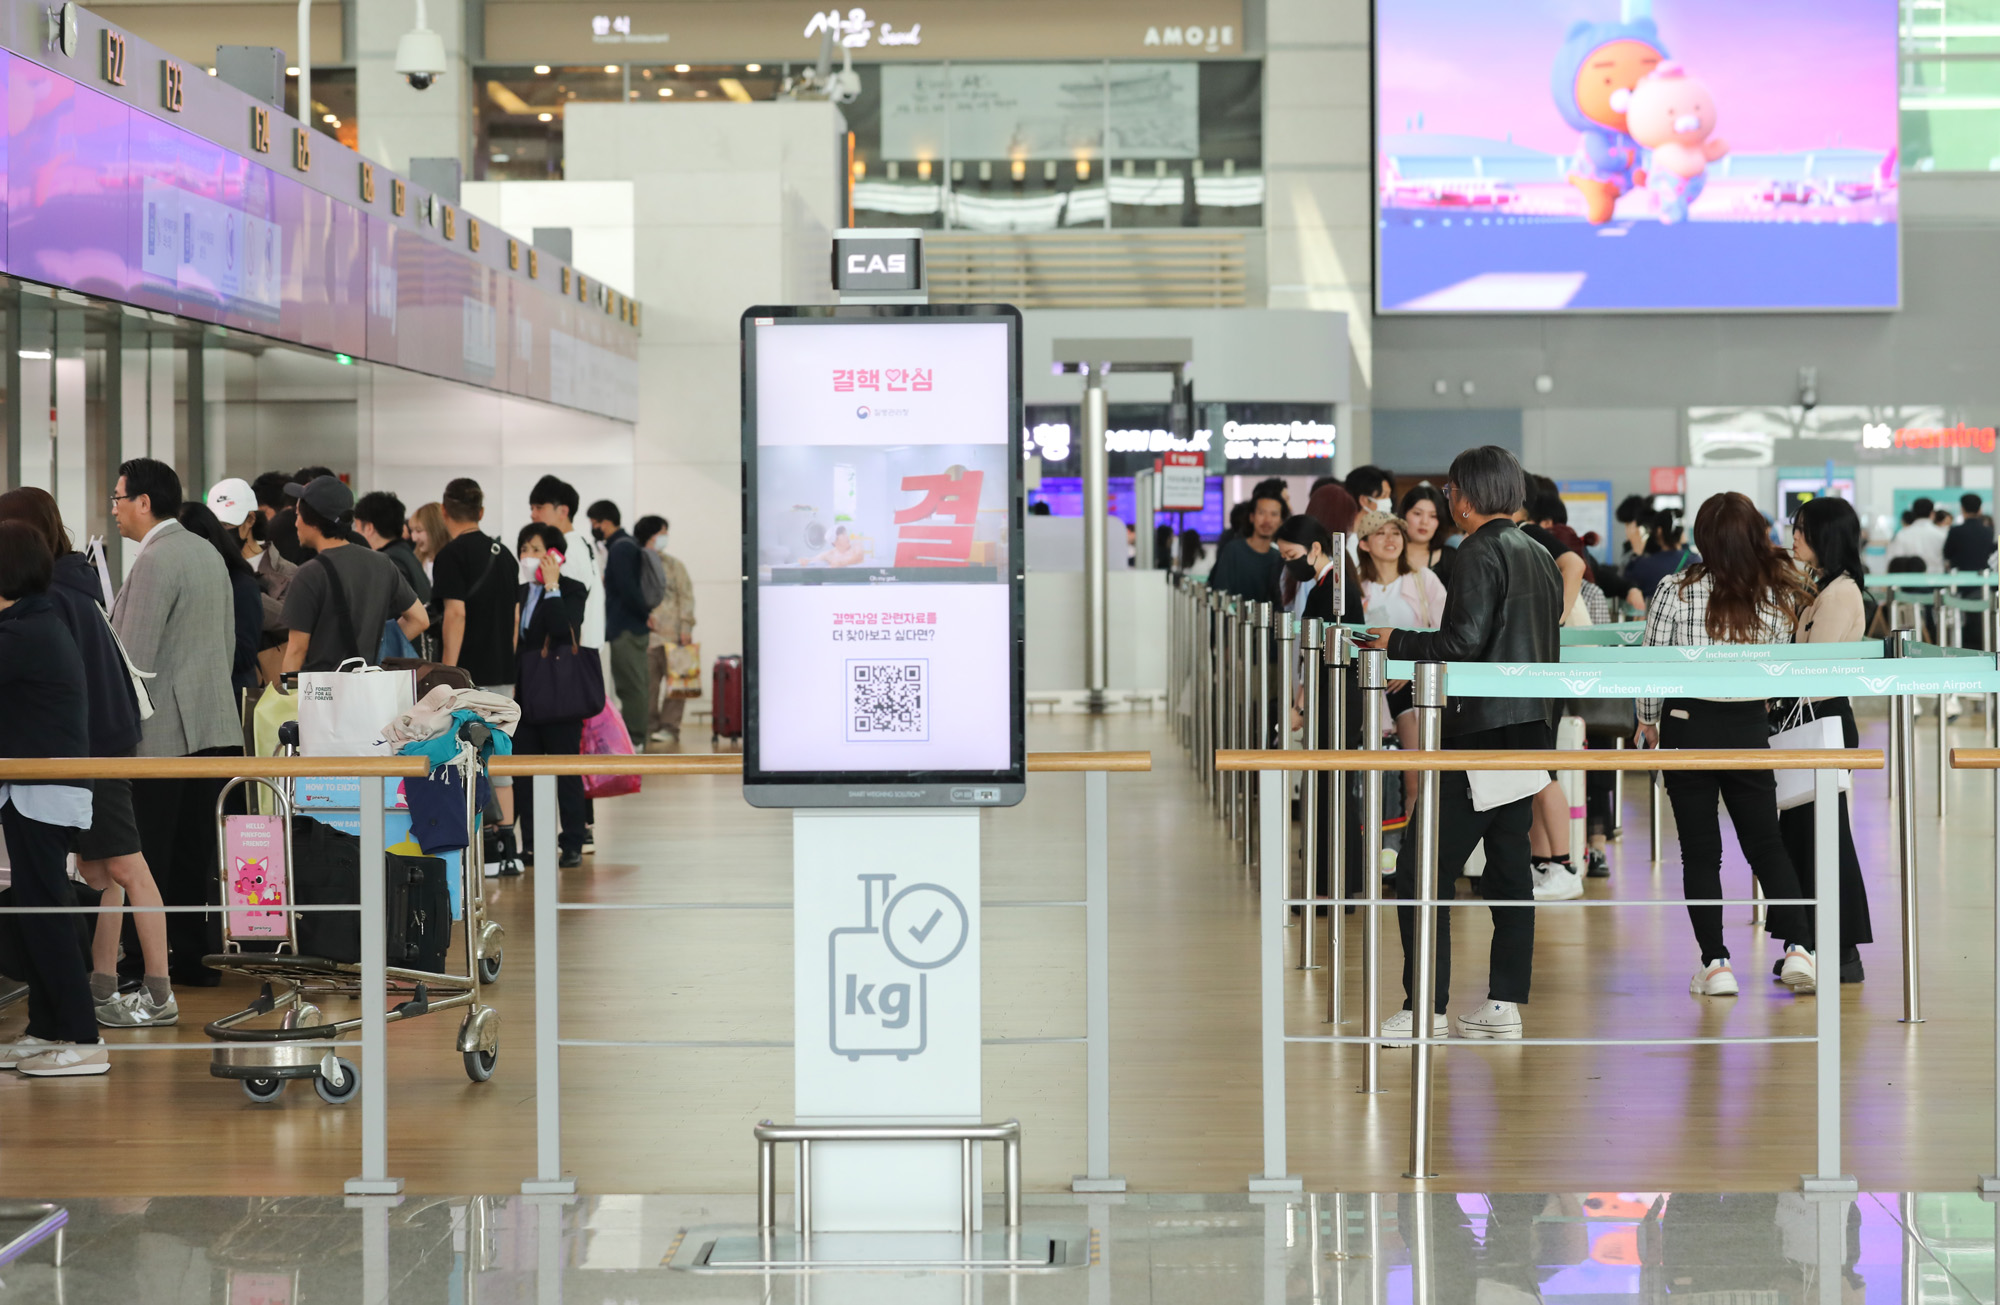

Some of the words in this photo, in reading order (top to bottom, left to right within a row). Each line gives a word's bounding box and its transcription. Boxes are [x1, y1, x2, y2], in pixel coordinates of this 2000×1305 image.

[101, 29, 126, 86] F22
[162, 60, 183, 112] F23
[251, 106, 270, 153] F24
[847, 254, 906, 273] CAS
[832, 369, 880, 392] 결핵
[885, 368, 933, 392] 안심
[893, 470, 984, 568] 결
[881, 612, 937, 625] 관련자료를
[832, 629, 843, 641] 더
[846, 629, 891, 641] 찾아보고
[894, 629, 935, 641] 싶다면?
[1704, 651, 1738, 660] Incheon
[1740, 650, 1771, 661] Airport
[1791, 666, 1829, 675] Incheon
[1831, 665, 1865, 677] Airport
[1598, 684, 1641, 694] Incheon
[1644, 684, 1684, 696] Airport
[1896, 680, 1940, 691] Incheon
[1943, 679, 1983, 693] Airport
[305, 783, 324, 791] HOW
[325, 783, 336, 791] TO
[242, 840, 270, 848] FRIENDS!
[845, 973, 911, 1030] kg
